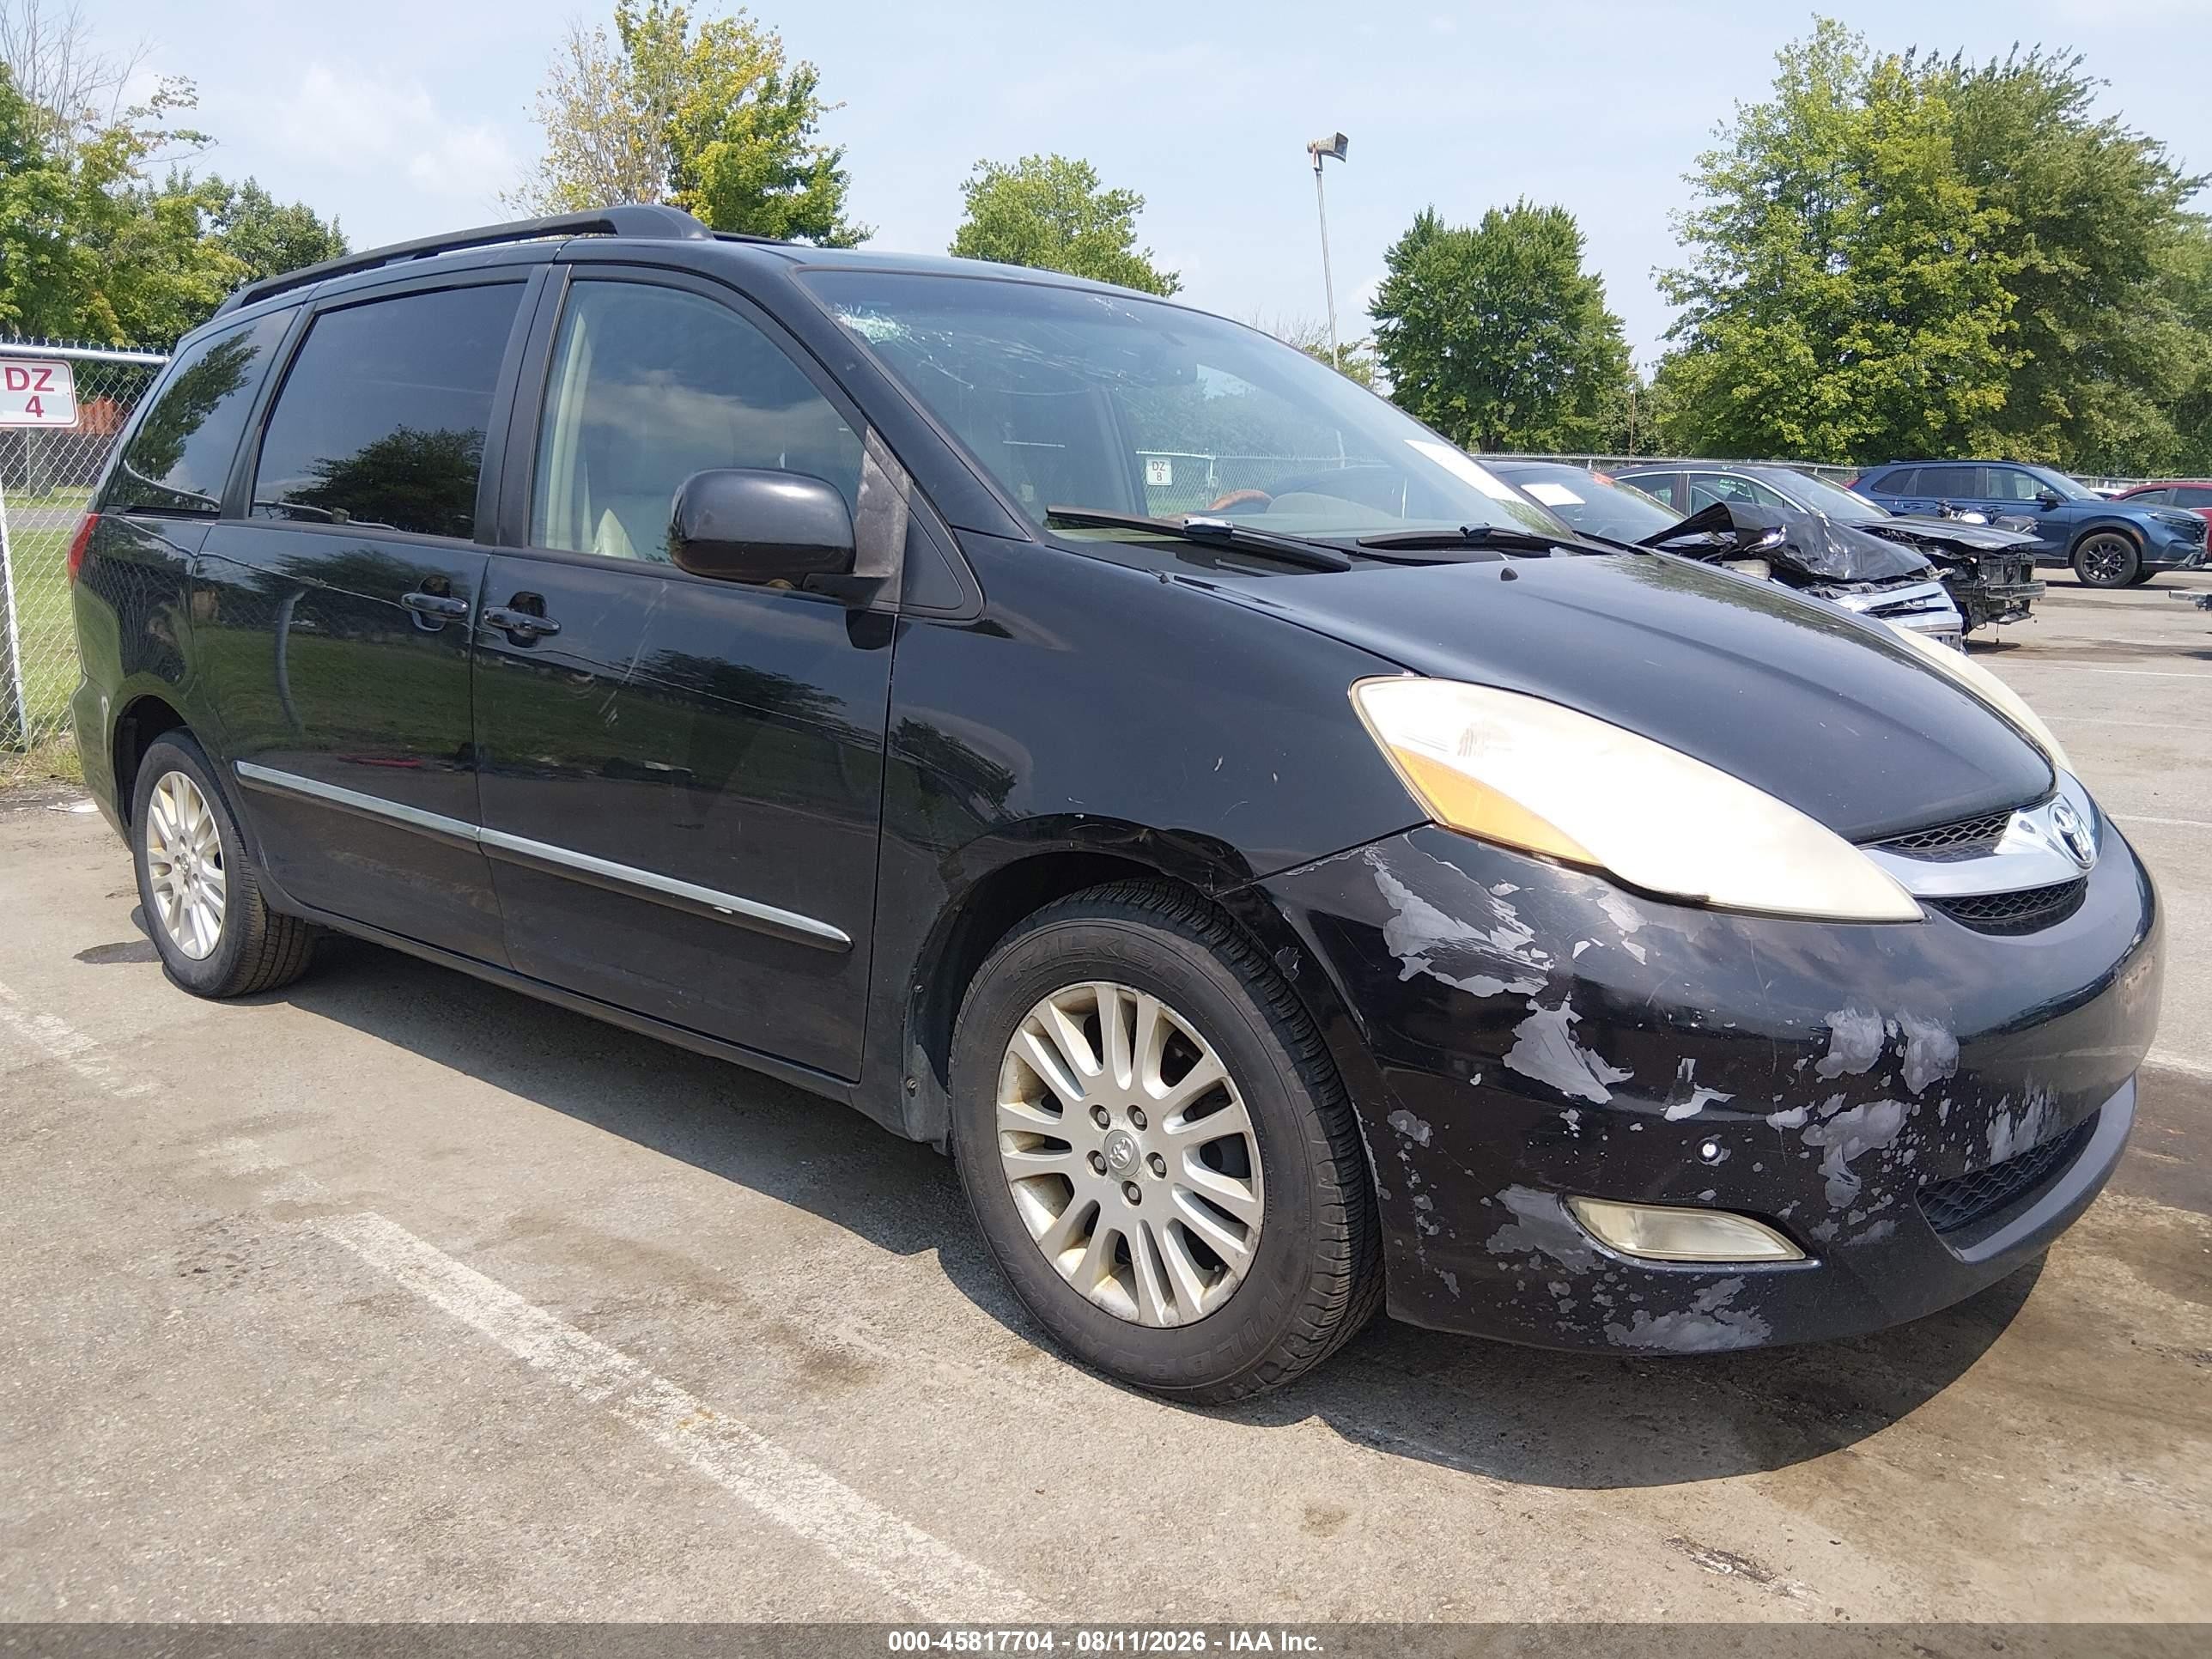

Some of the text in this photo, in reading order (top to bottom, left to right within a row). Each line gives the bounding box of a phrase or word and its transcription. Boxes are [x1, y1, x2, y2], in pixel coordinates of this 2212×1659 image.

[4, 367, 55, 392] DZ
[25, 395, 45, 418] 4
[1152, 461, 1166, 471] DZ
[1156, 471, 1163, 481] 8
